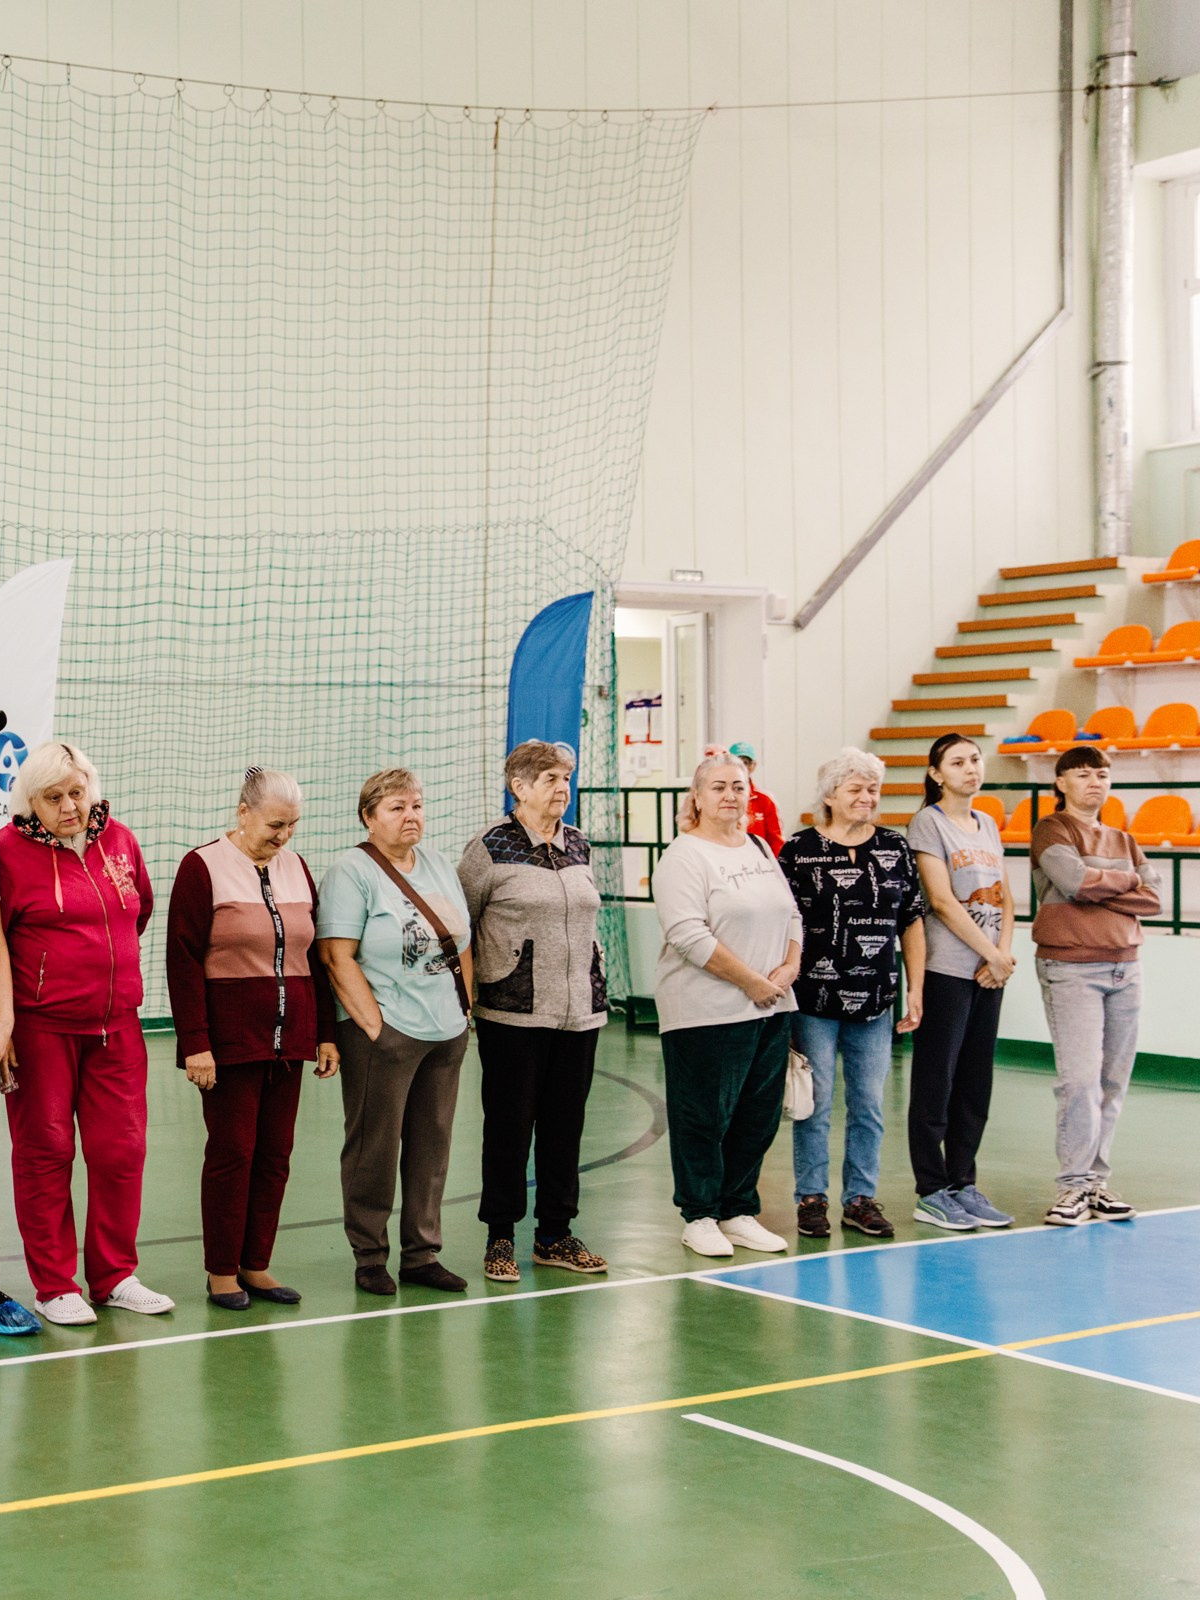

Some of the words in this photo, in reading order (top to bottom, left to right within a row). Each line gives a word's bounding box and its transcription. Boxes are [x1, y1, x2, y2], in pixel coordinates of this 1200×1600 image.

[868, 862, 879, 908] AUTHENTIC
[831, 893, 840, 946] AUTHENTIC
[847, 916, 872, 926] party
